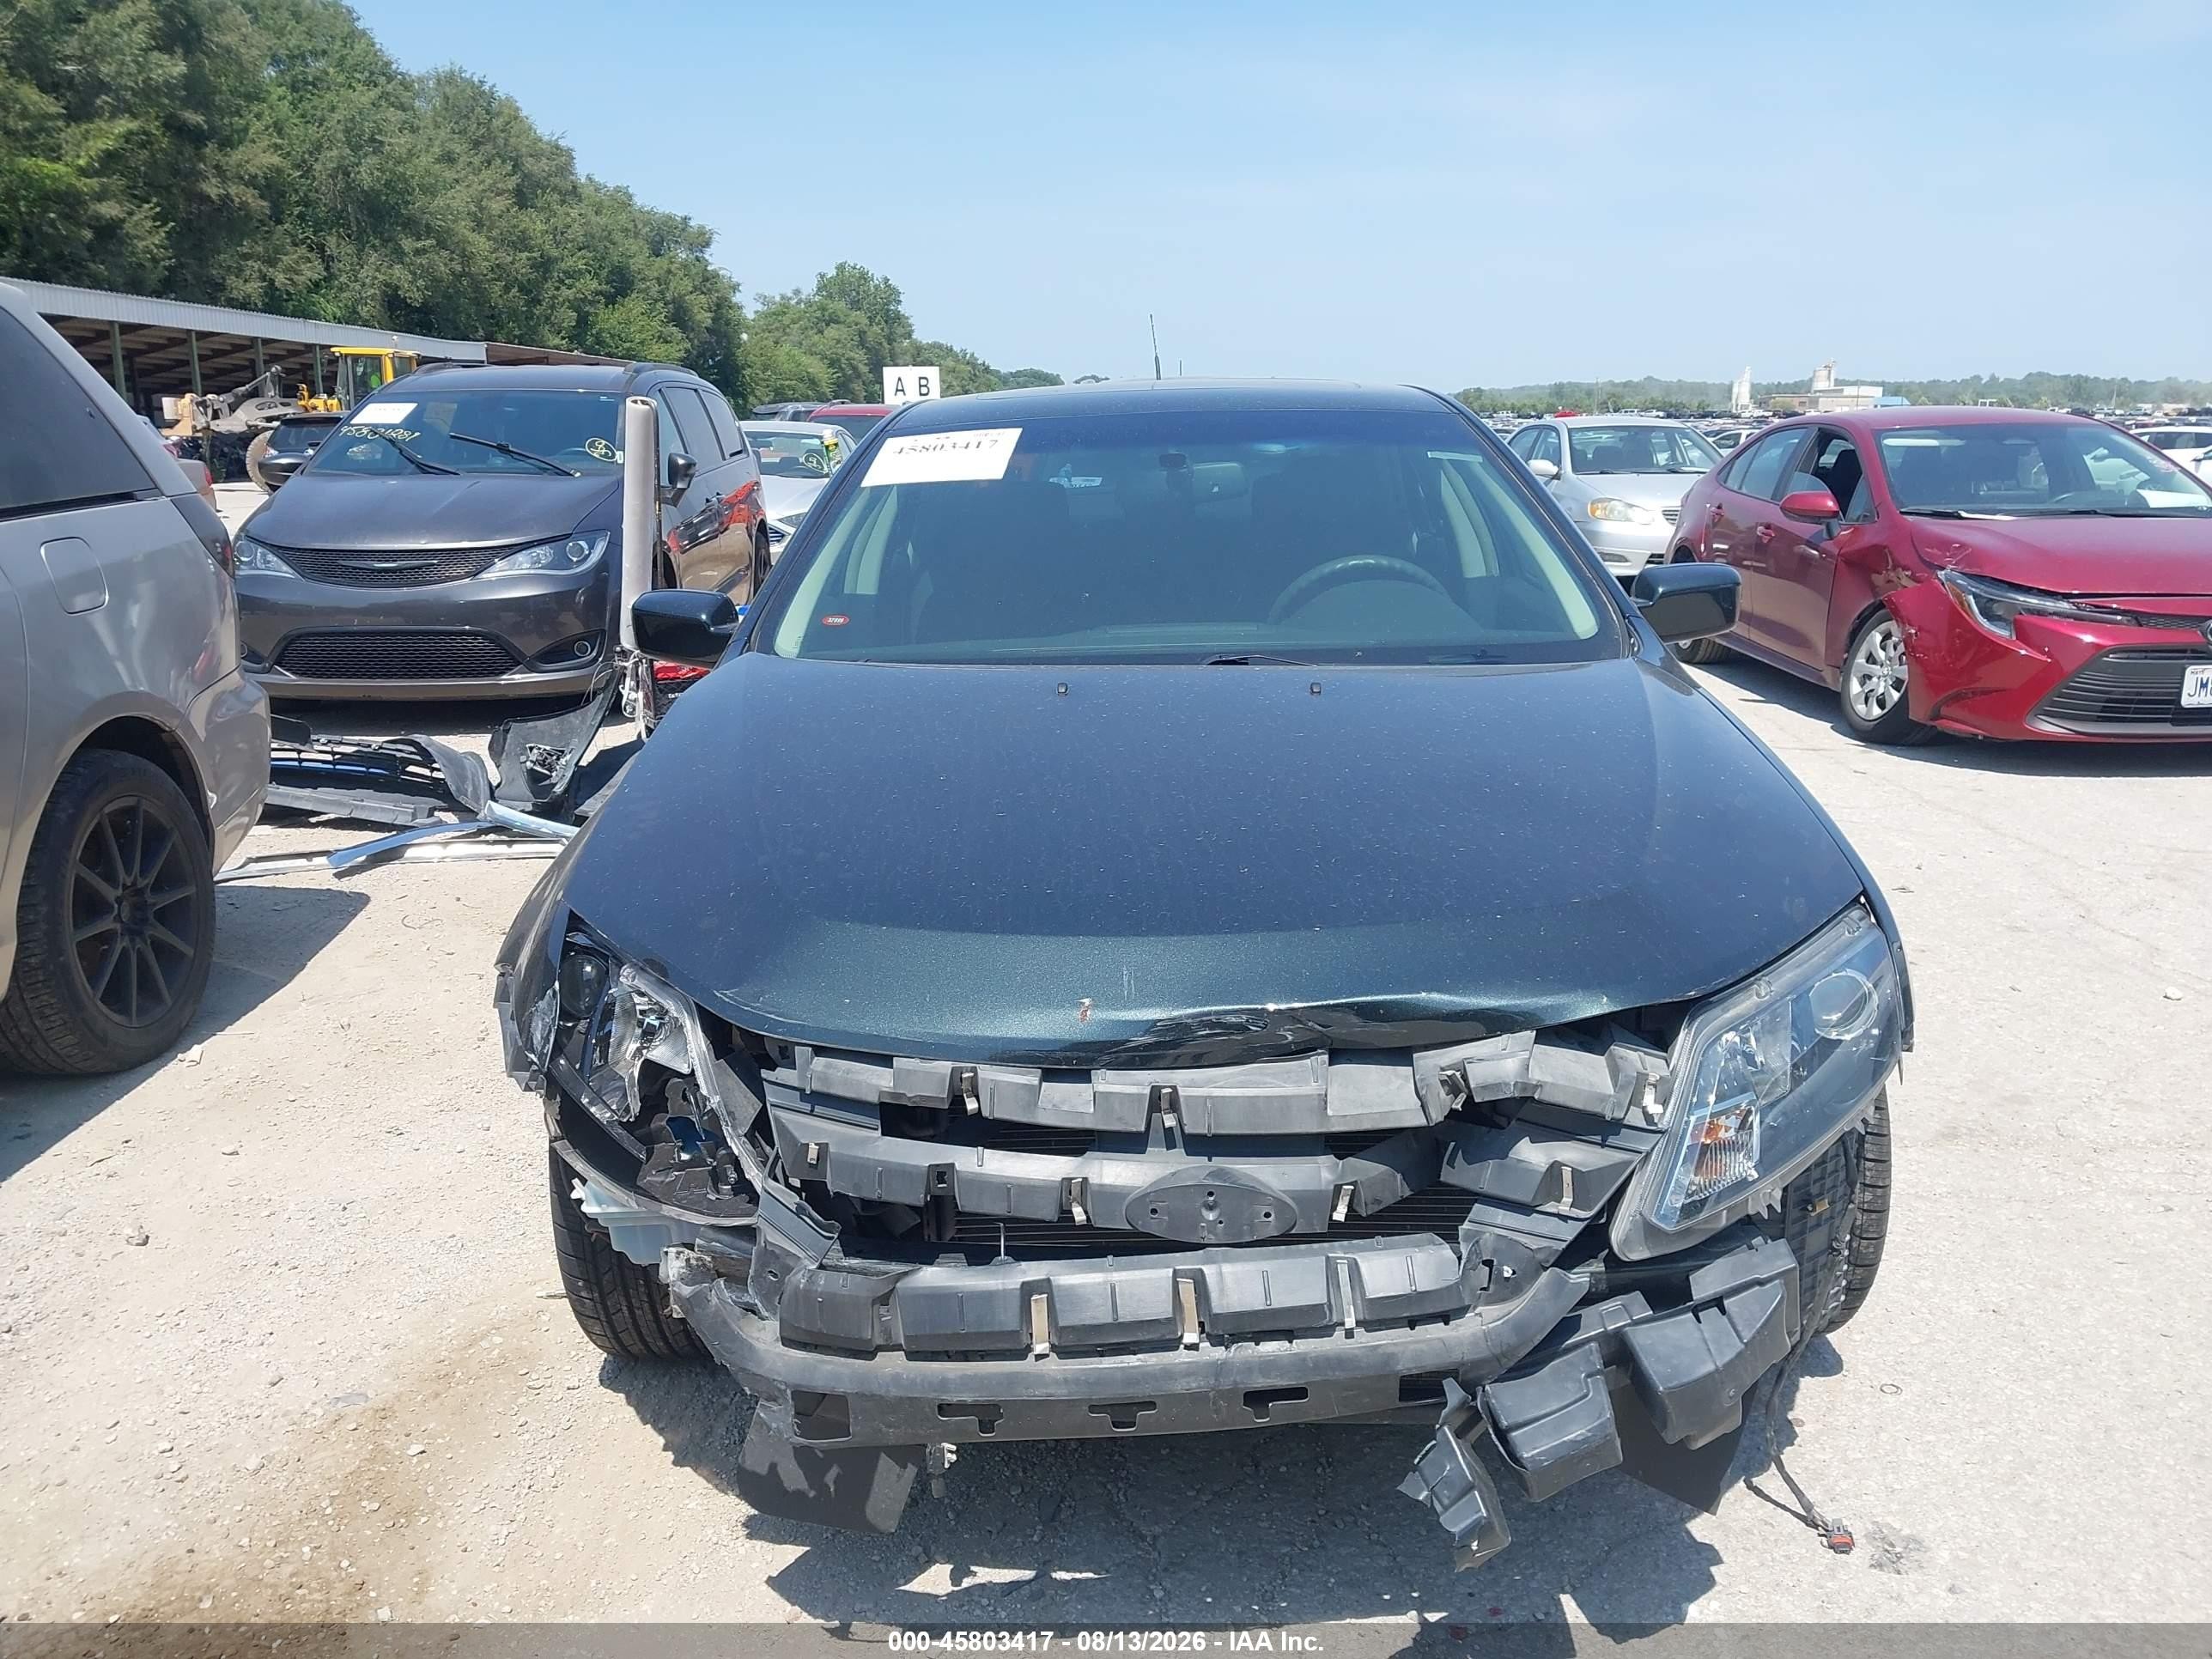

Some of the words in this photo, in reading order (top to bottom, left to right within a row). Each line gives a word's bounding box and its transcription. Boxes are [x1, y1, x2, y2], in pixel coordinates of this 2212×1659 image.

[894, 376, 906, 397] A
[918, 376, 930, 397] B
[2187, 676, 2212, 697] JM
